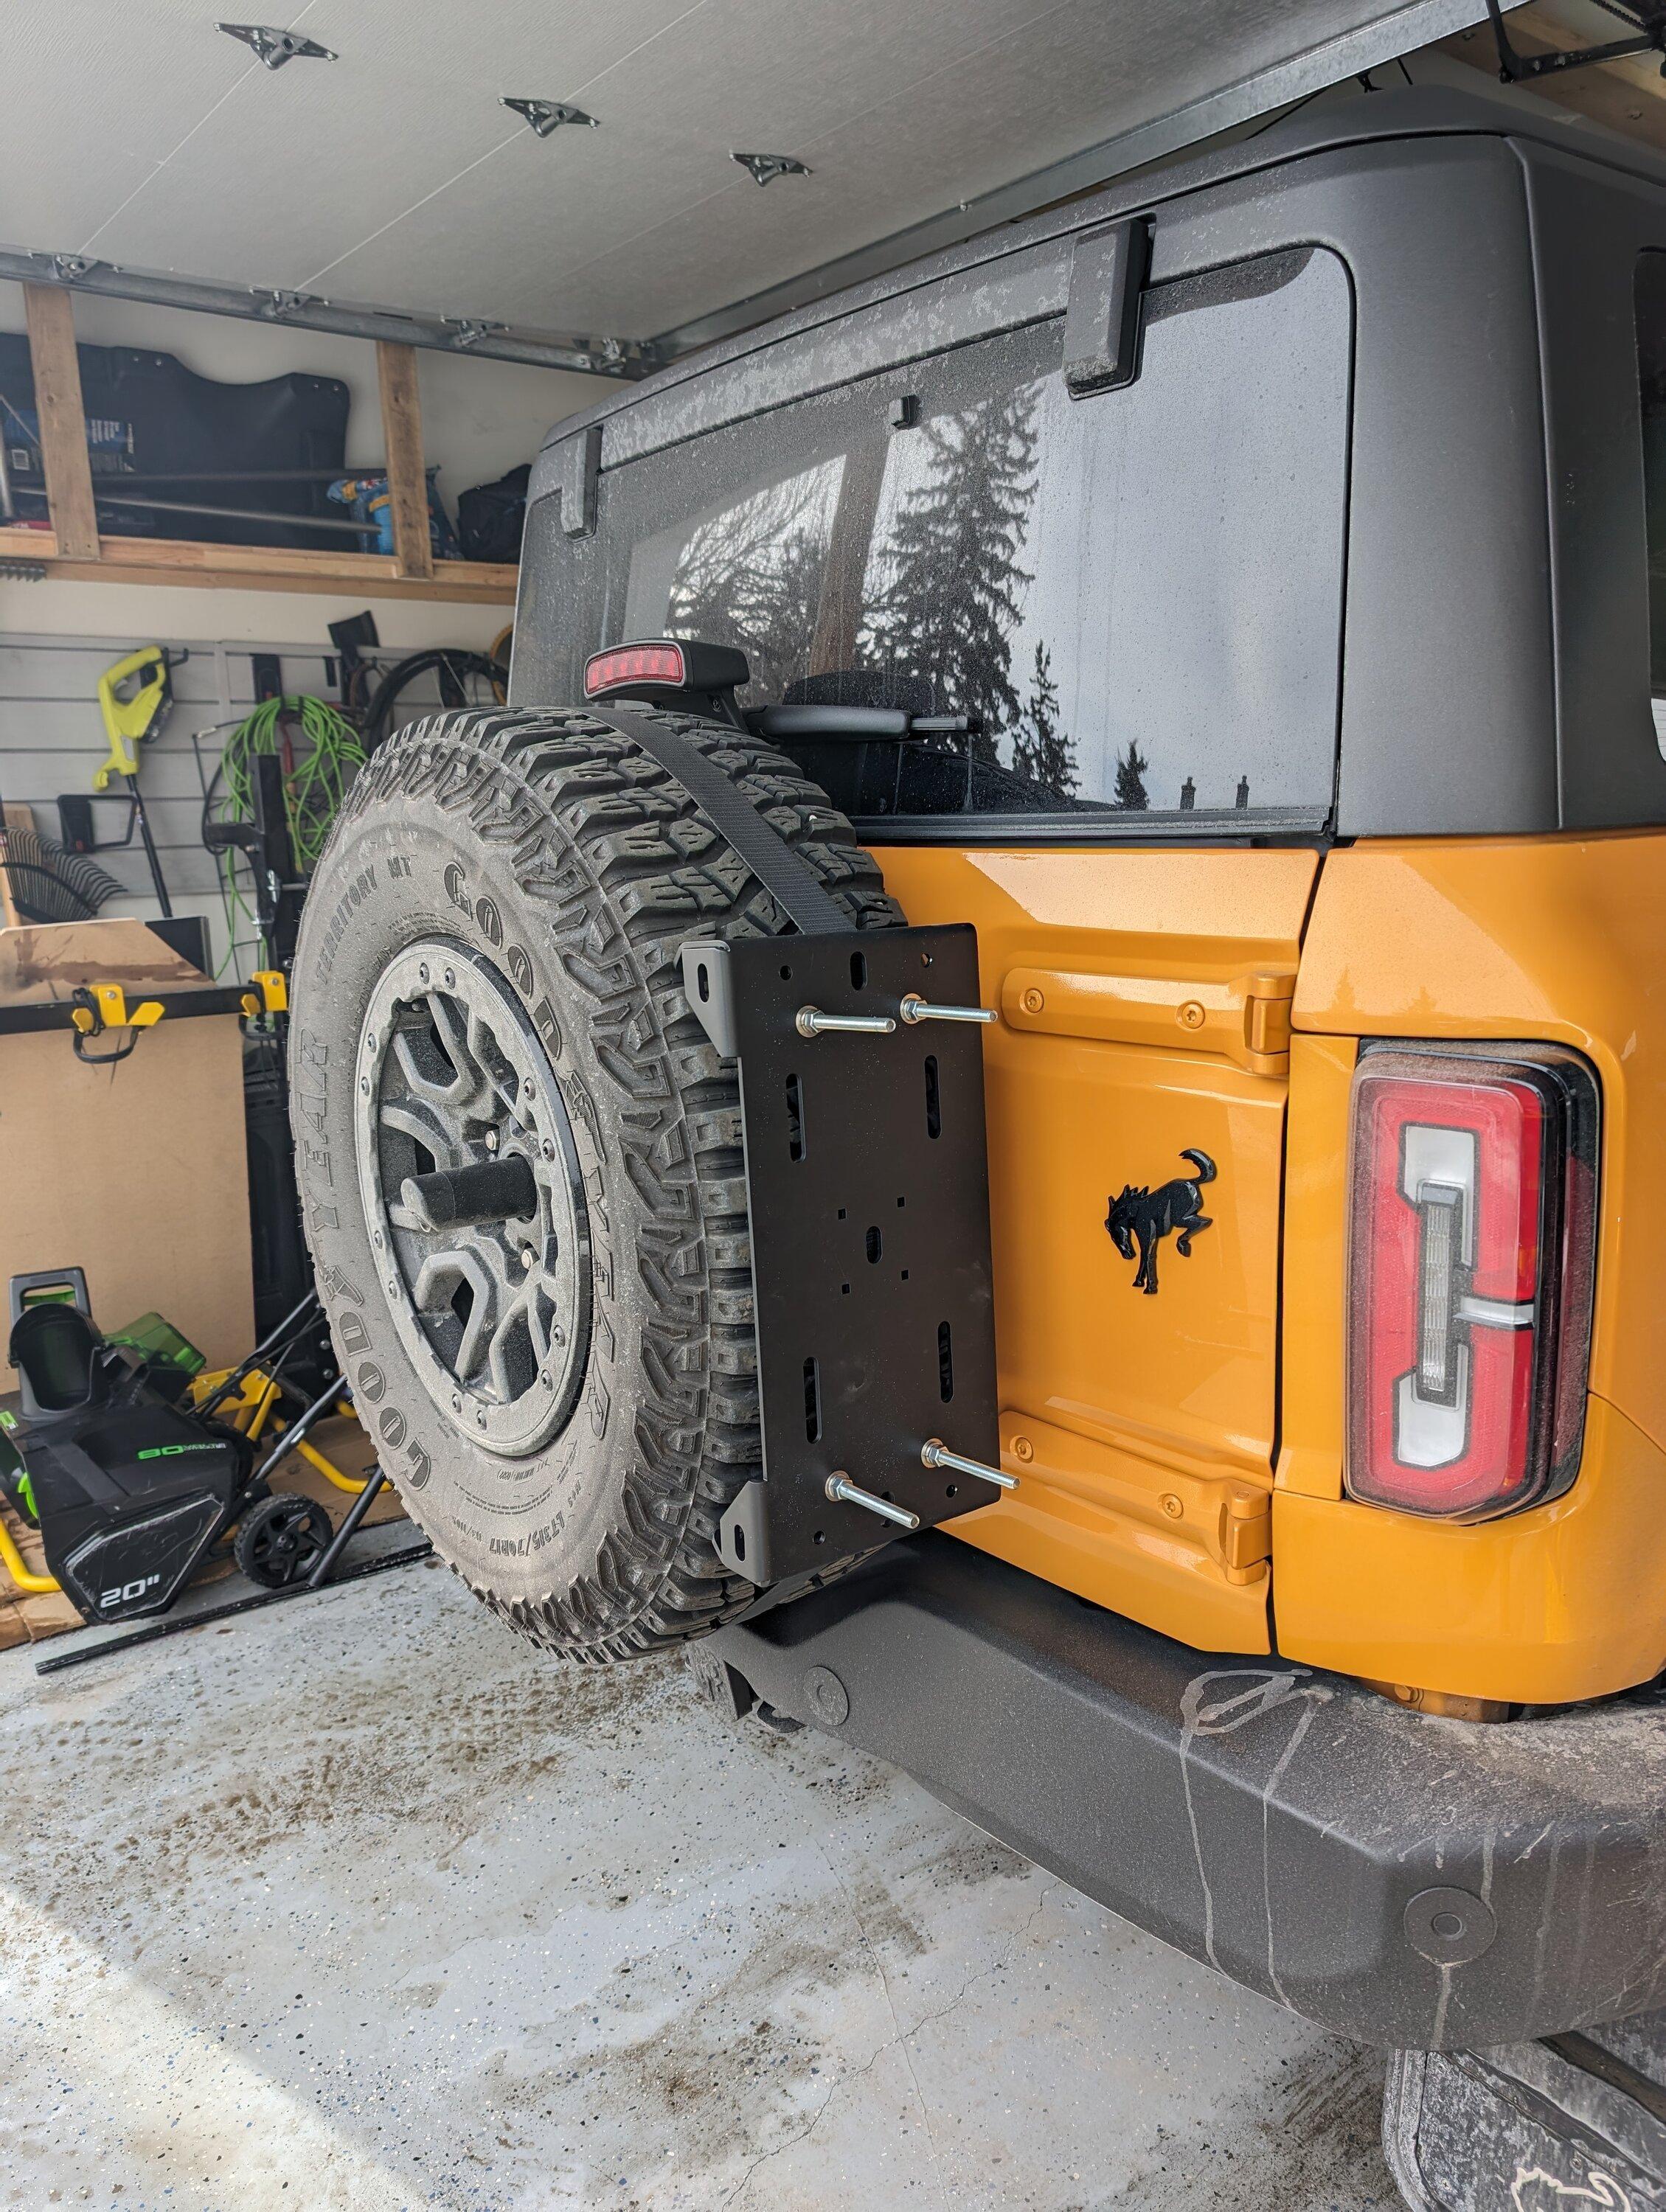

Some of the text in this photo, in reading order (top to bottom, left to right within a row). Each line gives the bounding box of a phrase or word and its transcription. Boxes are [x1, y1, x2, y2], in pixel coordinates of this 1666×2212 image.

[316, 863, 377, 985] TERRITORY
[387, 856, 412, 880] MT
[489, 1511, 565, 1556] LT315/70R17
[101, 1574, 159, 1608] 20"
